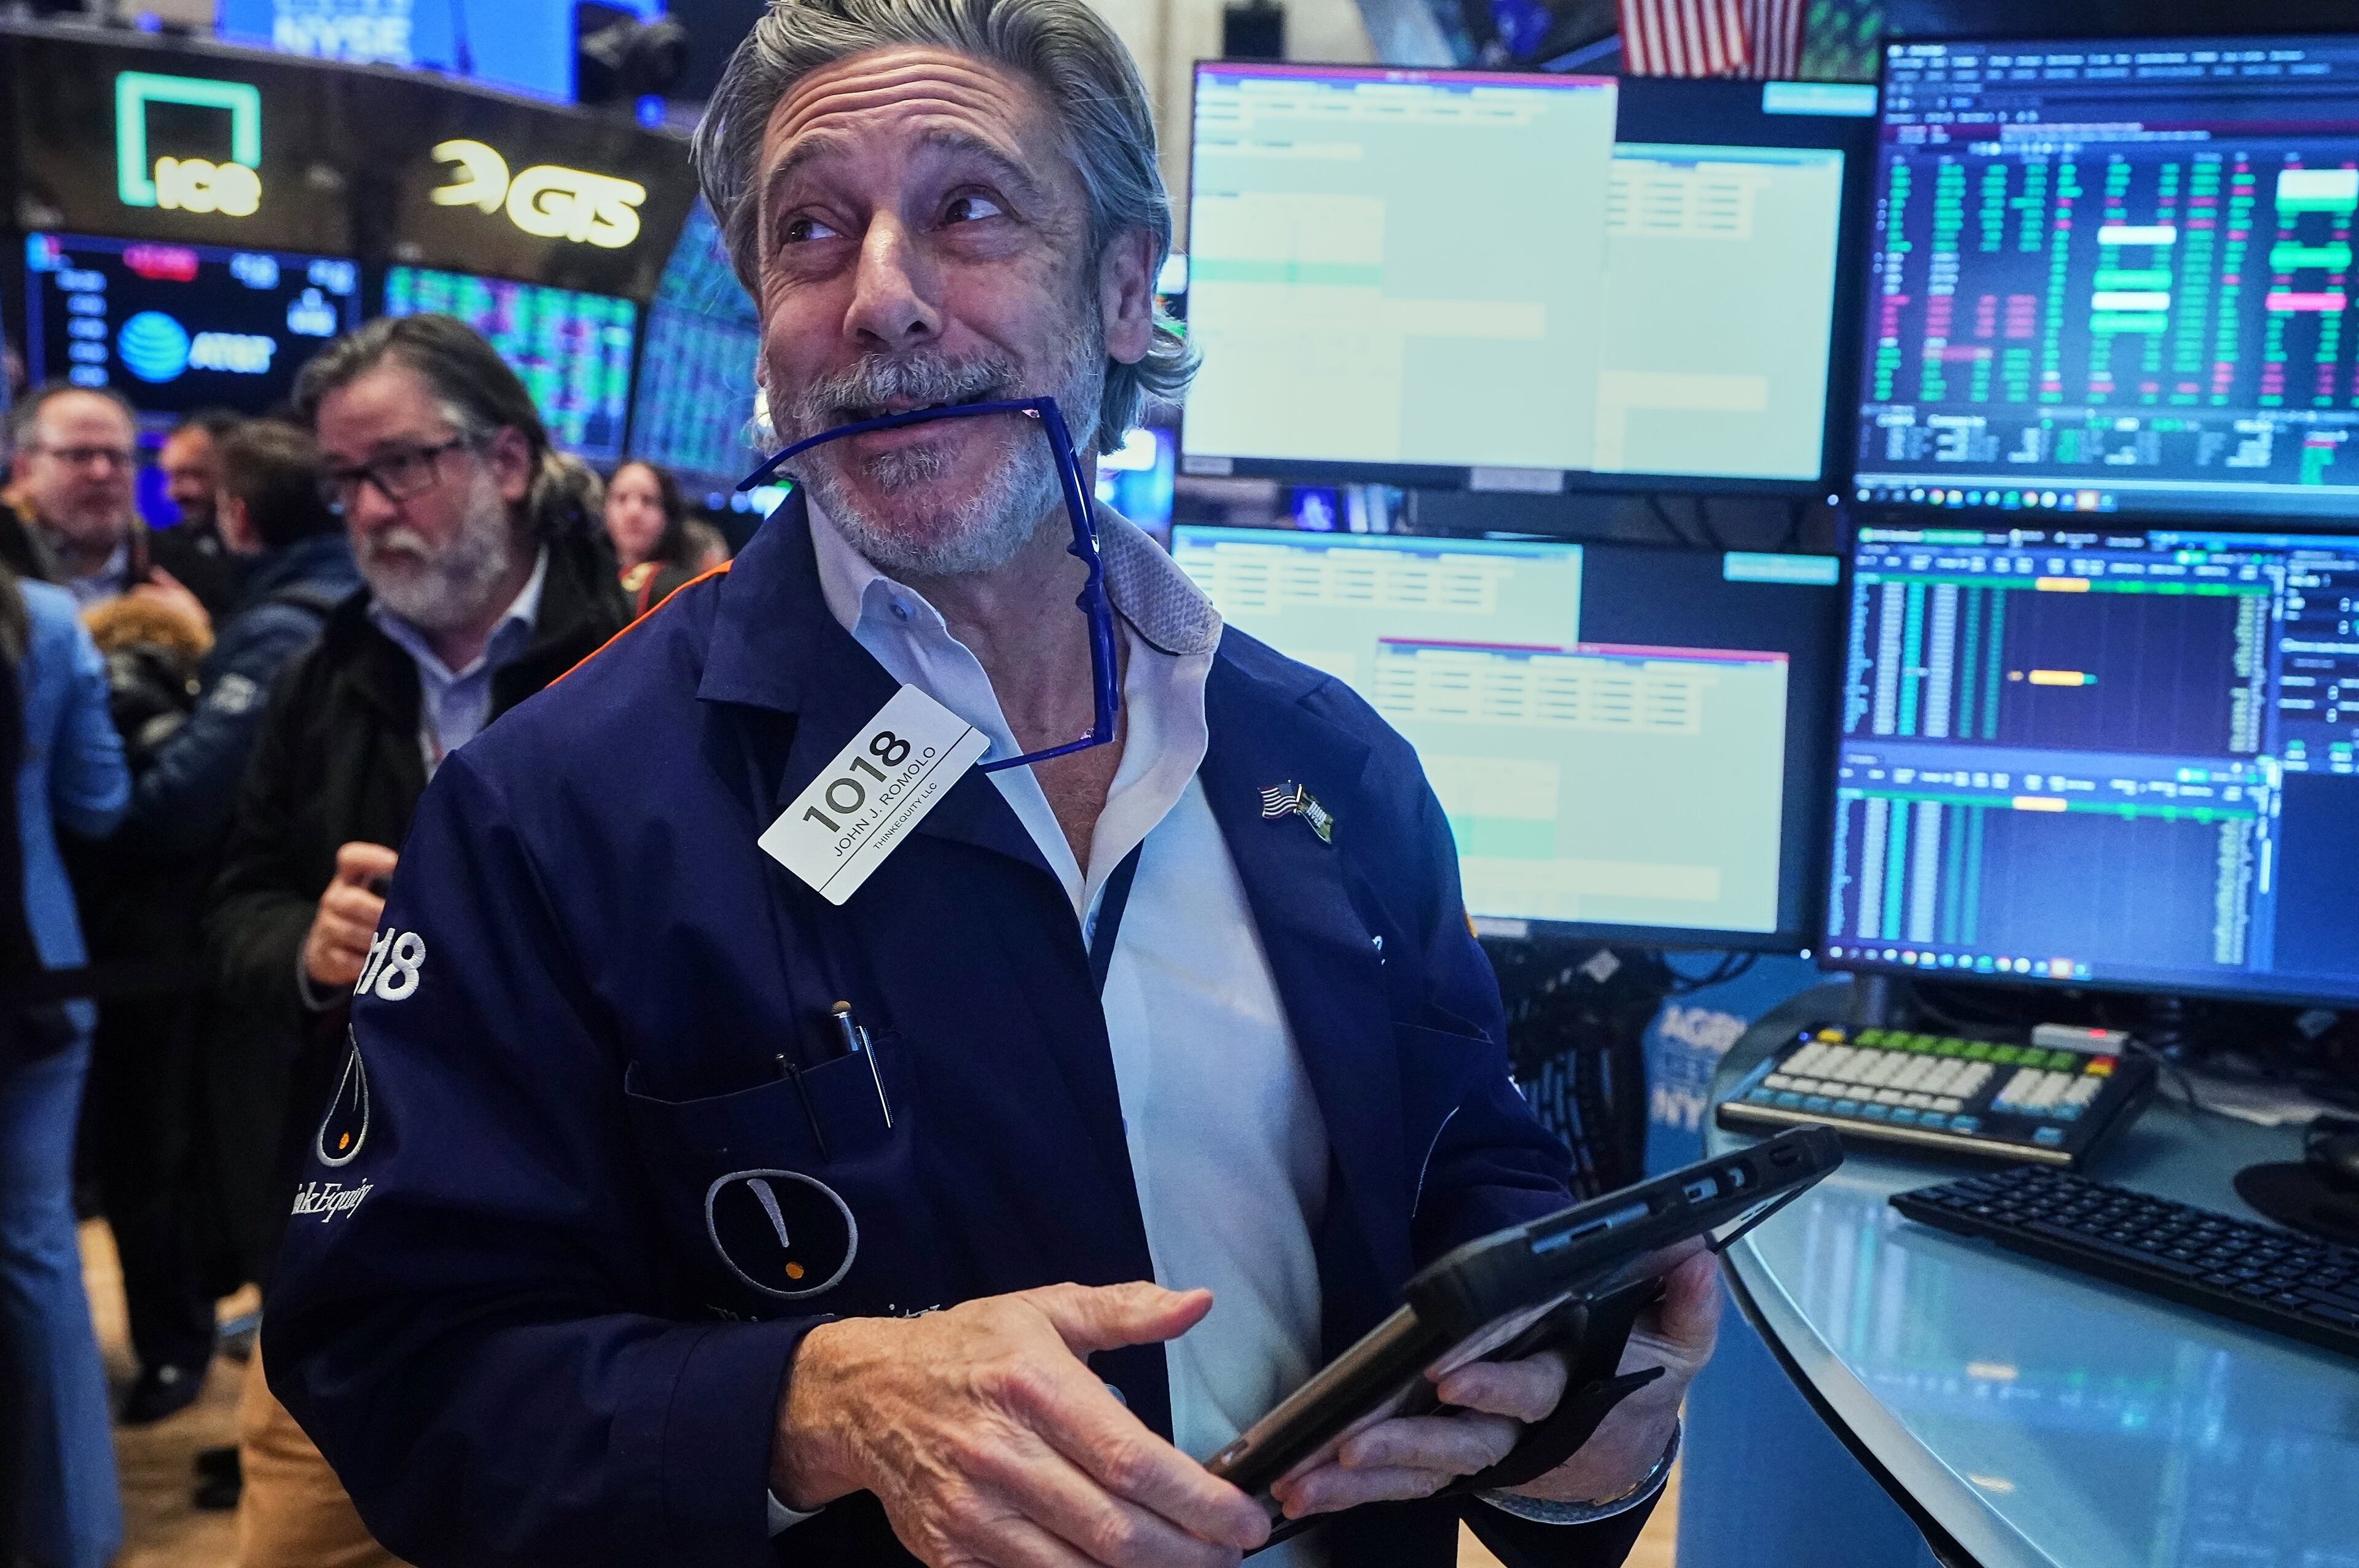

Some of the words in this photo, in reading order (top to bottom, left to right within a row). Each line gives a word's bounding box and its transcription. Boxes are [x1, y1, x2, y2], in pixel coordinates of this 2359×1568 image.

[505, 163, 647, 249] GTS
[802, 731, 910, 833] 1018
[834, 818, 870, 857] JOHN
[869, 808, 882, 819] J.
[879, 747, 936, 805] ROMOLO
[873, 798, 922, 849] THINKEQUITY
[921, 782, 937, 798] LLC
[353, 927, 426, 1001] 18
